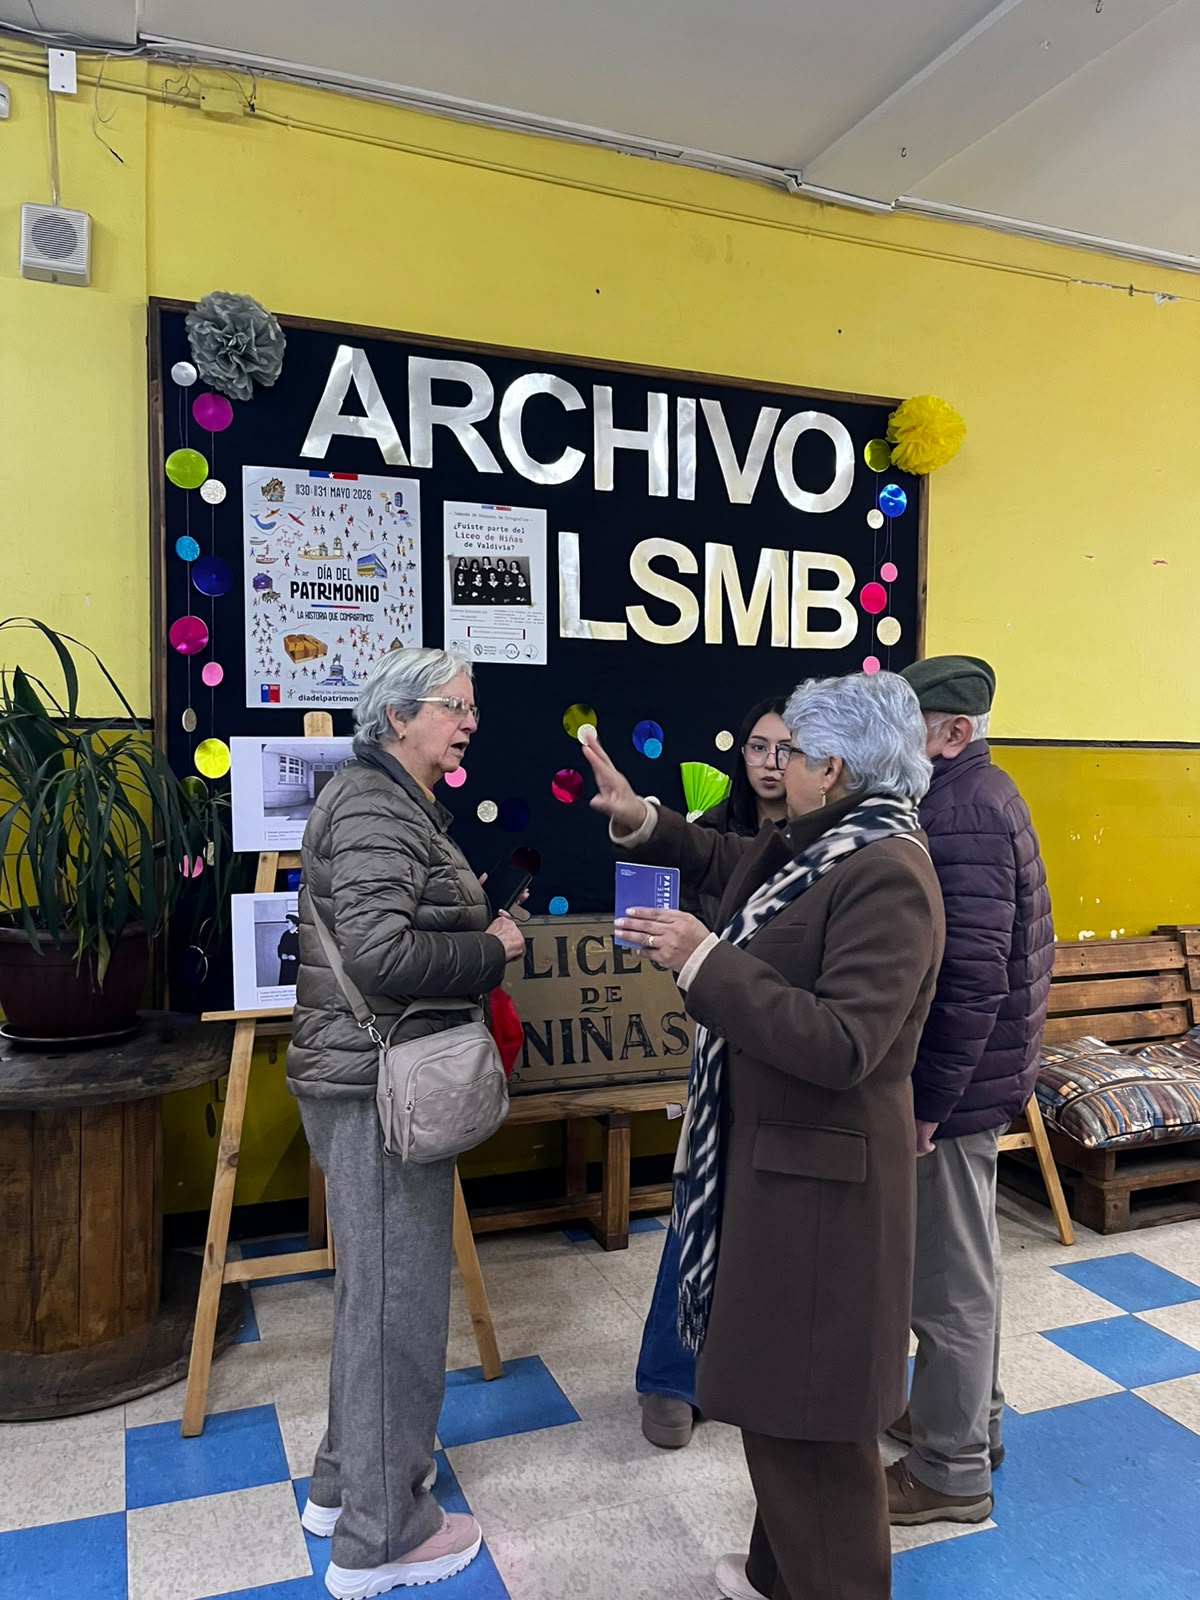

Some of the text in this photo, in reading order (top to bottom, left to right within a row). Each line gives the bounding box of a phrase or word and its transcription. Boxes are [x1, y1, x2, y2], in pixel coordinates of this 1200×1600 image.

[300, 344, 855, 514] ARCHIVO
[300, 484, 310, 496] 30
[318, 485, 327, 497] 31
[330, 487, 351, 499] MAYO
[353, 488, 372, 501] 2026
[453, 522, 484, 531] ¿Fuiste
[487, 525, 509, 533] parte
[455, 531, 524, 544] Liceo de Niñas
[477, 542, 515, 551] Valdivia?
[317, 564, 352, 581] DÍA DEL
[290, 581, 380, 603] PATRIMONIO
[558, 531, 858, 649] LSMB
[297, 611, 375, 623] LA HISTORIA QUE COMPARTIMOS
[298, 694, 360, 703] diadelpatrimon
[656, 887, 664, 909] ORTE
[663, 875, 671, 910] PATRIM
[523, 935, 669, 980] LICE
[580, 986, 623, 1005] DE
[520, 1006, 690, 1069] NIÑAS
